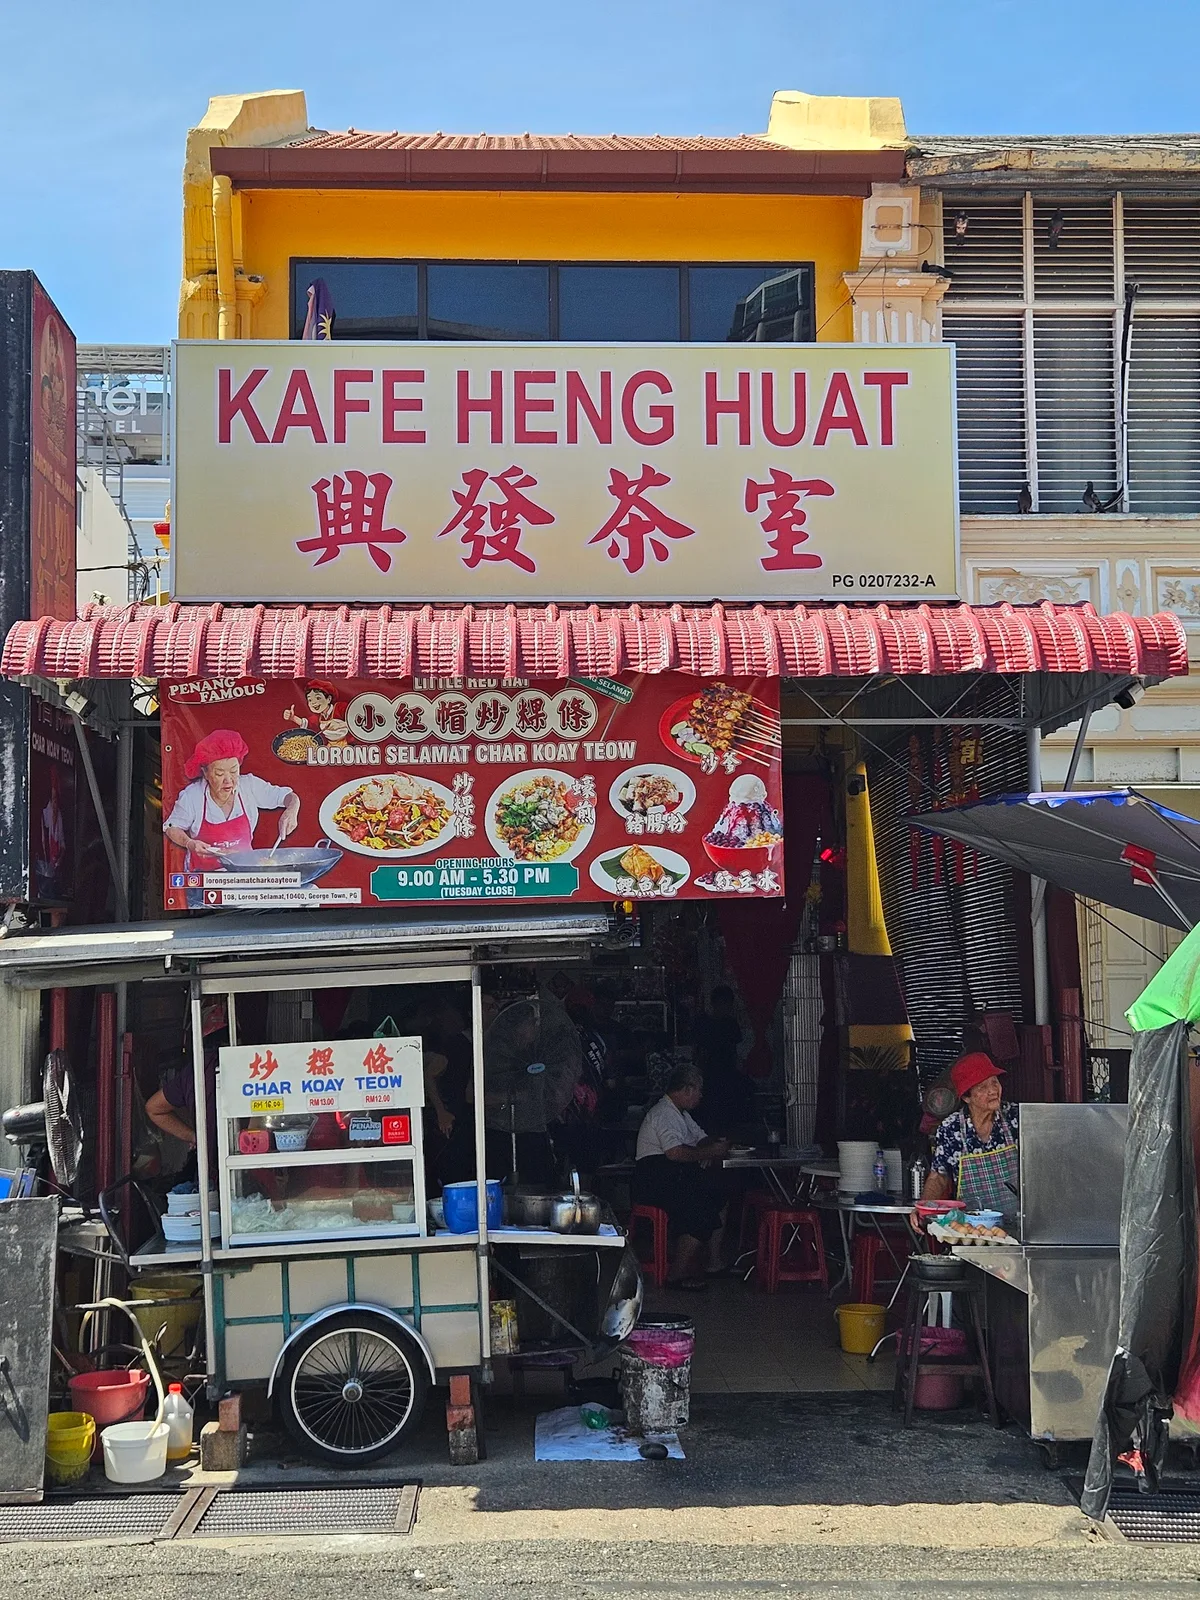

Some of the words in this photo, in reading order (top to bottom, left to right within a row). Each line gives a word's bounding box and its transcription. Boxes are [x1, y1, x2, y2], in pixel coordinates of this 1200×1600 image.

[217, 370, 426, 443] KAFE
[457, 371, 674, 445] HENG
[705, 372, 909, 446] HUAT
[296, 464, 836, 573] 興發茶室
[832, 575, 854, 587] PG
[859, 574, 936, 587] 0207232-A
[169, 678, 236, 696] PENANG
[199, 683, 265, 703] FAMOUS
[597, 678, 631, 697] SELAMAT
[307, 746, 381, 765] LORONG
[386, 745, 471, 764] SELAMAT
[475, 743, 527, 763] CHAR
[532, 742, 579, 762] KOAY
[583, 740, 637, 760] TEOW
[436, 858, 479, 869] OPENING
[482, 857, 515, 868] HOURS
[205, 877, 298, 885] lorongselamatcharkoayteow
[398, 870, 434, 886] 9.00
[439, 870, 465, 885] AM
[483, 869, 518, 885] 5.30
[524, 867, 550, 884] PM
[238, 893, 258, 901] Lorong
[440, 886, 483, 898] (TUESDAY
[485, 885, 516, 897] CLOSE)
[249, 1043, 394, 1081] 炒粿條
[242, 1081, 292, 1097] CHAR
[301, 1077, 345, 1093] KOAY
[354, 1074, 403, 1091] TEOW
